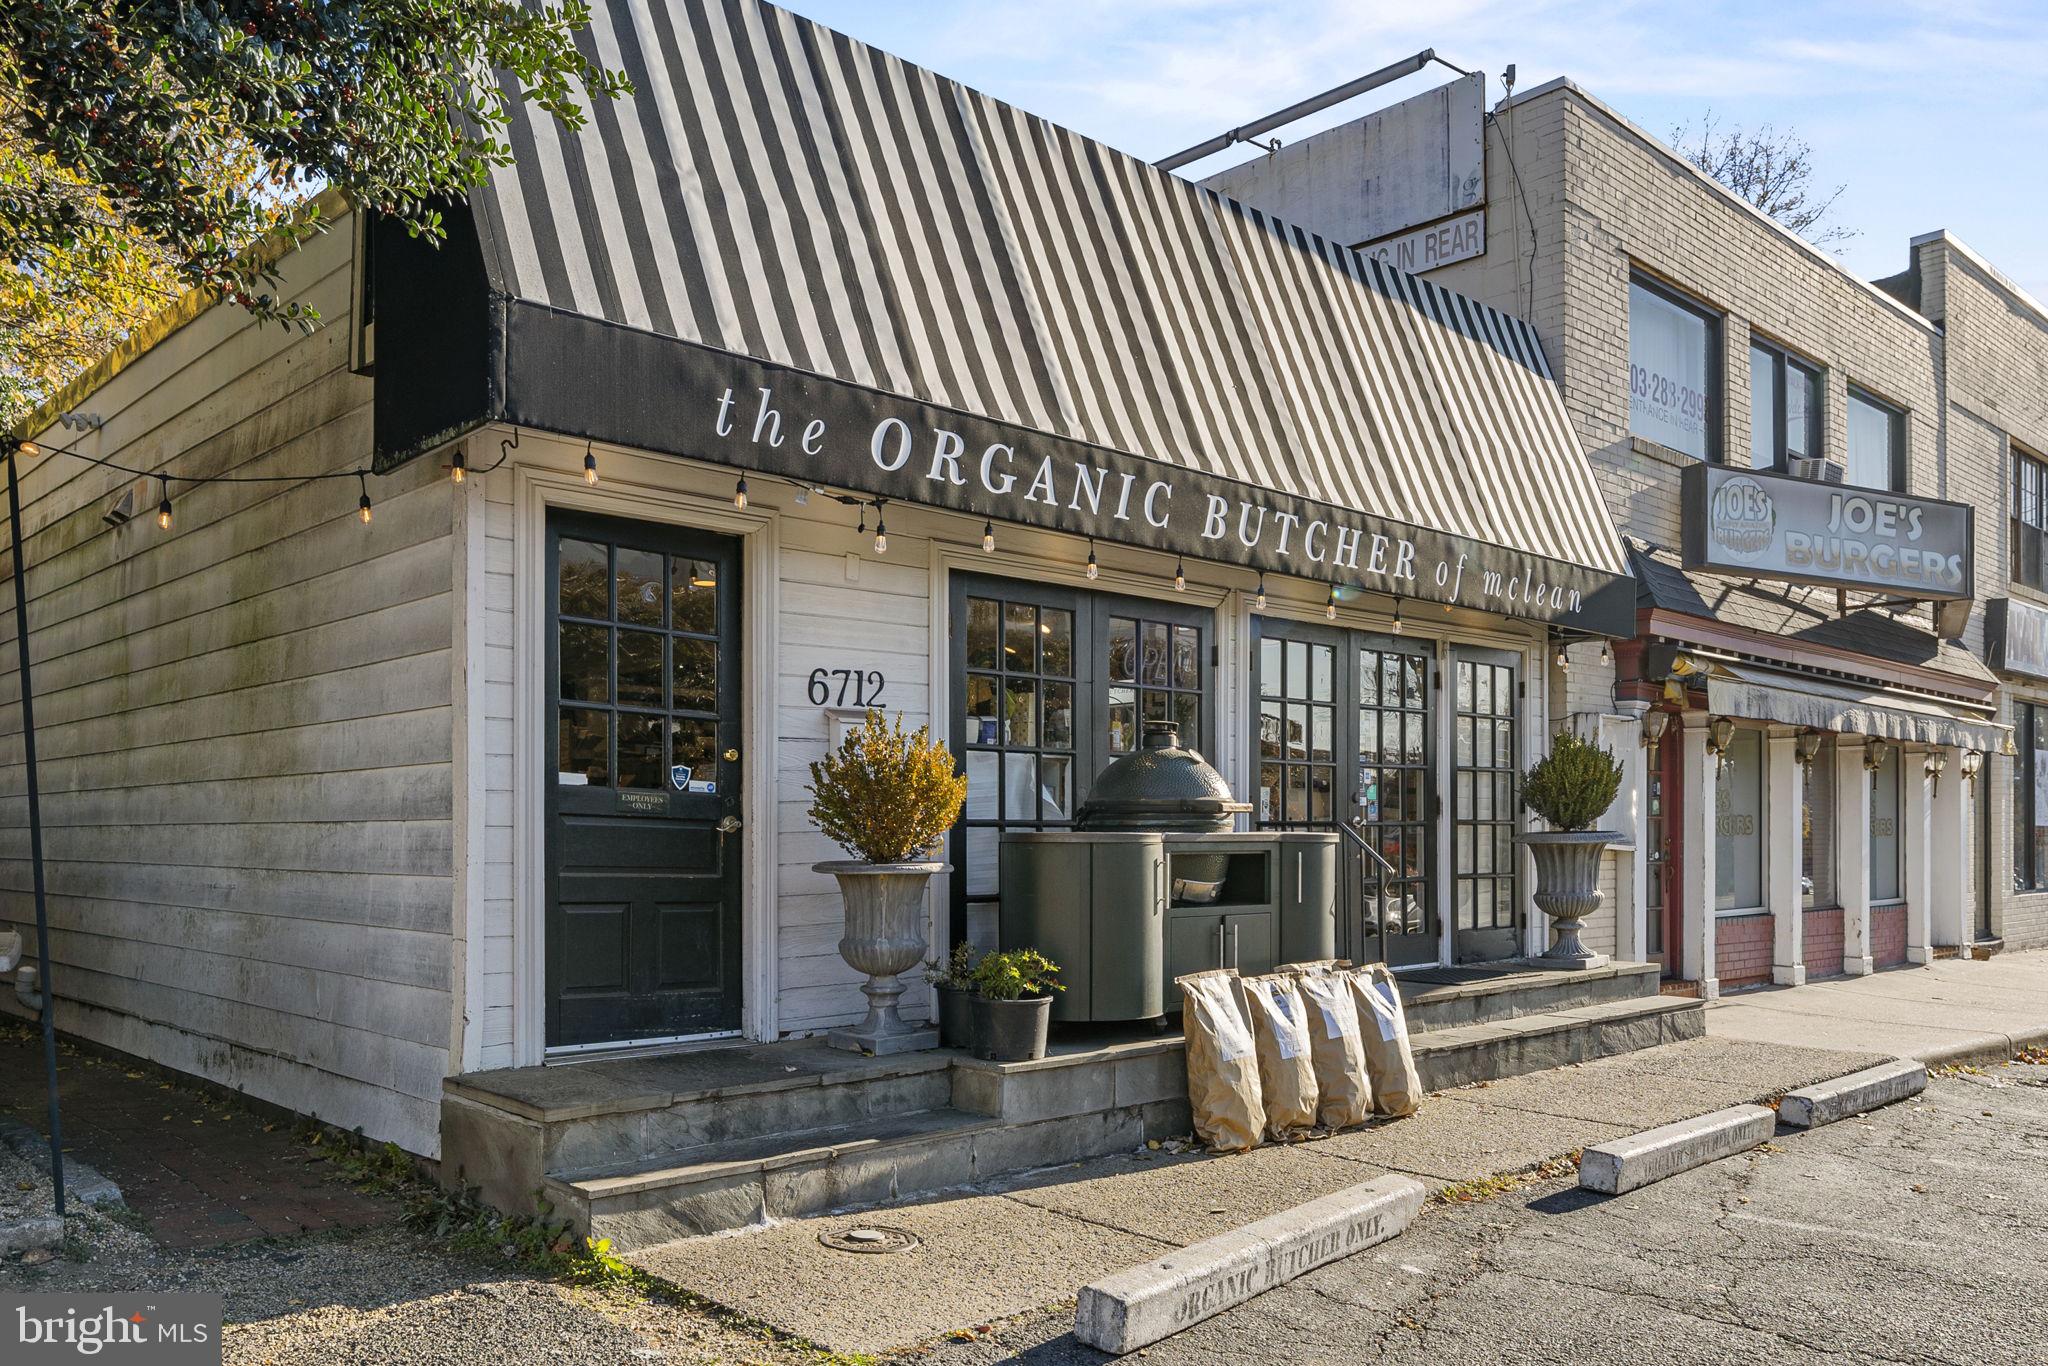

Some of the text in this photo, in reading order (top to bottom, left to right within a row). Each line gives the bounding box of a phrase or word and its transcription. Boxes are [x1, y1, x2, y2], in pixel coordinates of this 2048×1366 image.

[1396, 239, 1415, 270] IN
[1425, 220, 1479, 263] REAR
[716, 387, 1582, 614] the ORGANIC BUTCHER of mclean
[1826, 493, 1923, 542] JOE'S
[1784, 530, 1962, 586] BURGERS
[807, 667, 887, 708] 6712
[621, 793, 664, 803] EMPLOYEES
[632, 802, 653, 810] ONLY
[1174, 1264, 1259, 1324] ORGANIC
[1264, 1230, 1341, 1284] BUTCHER
